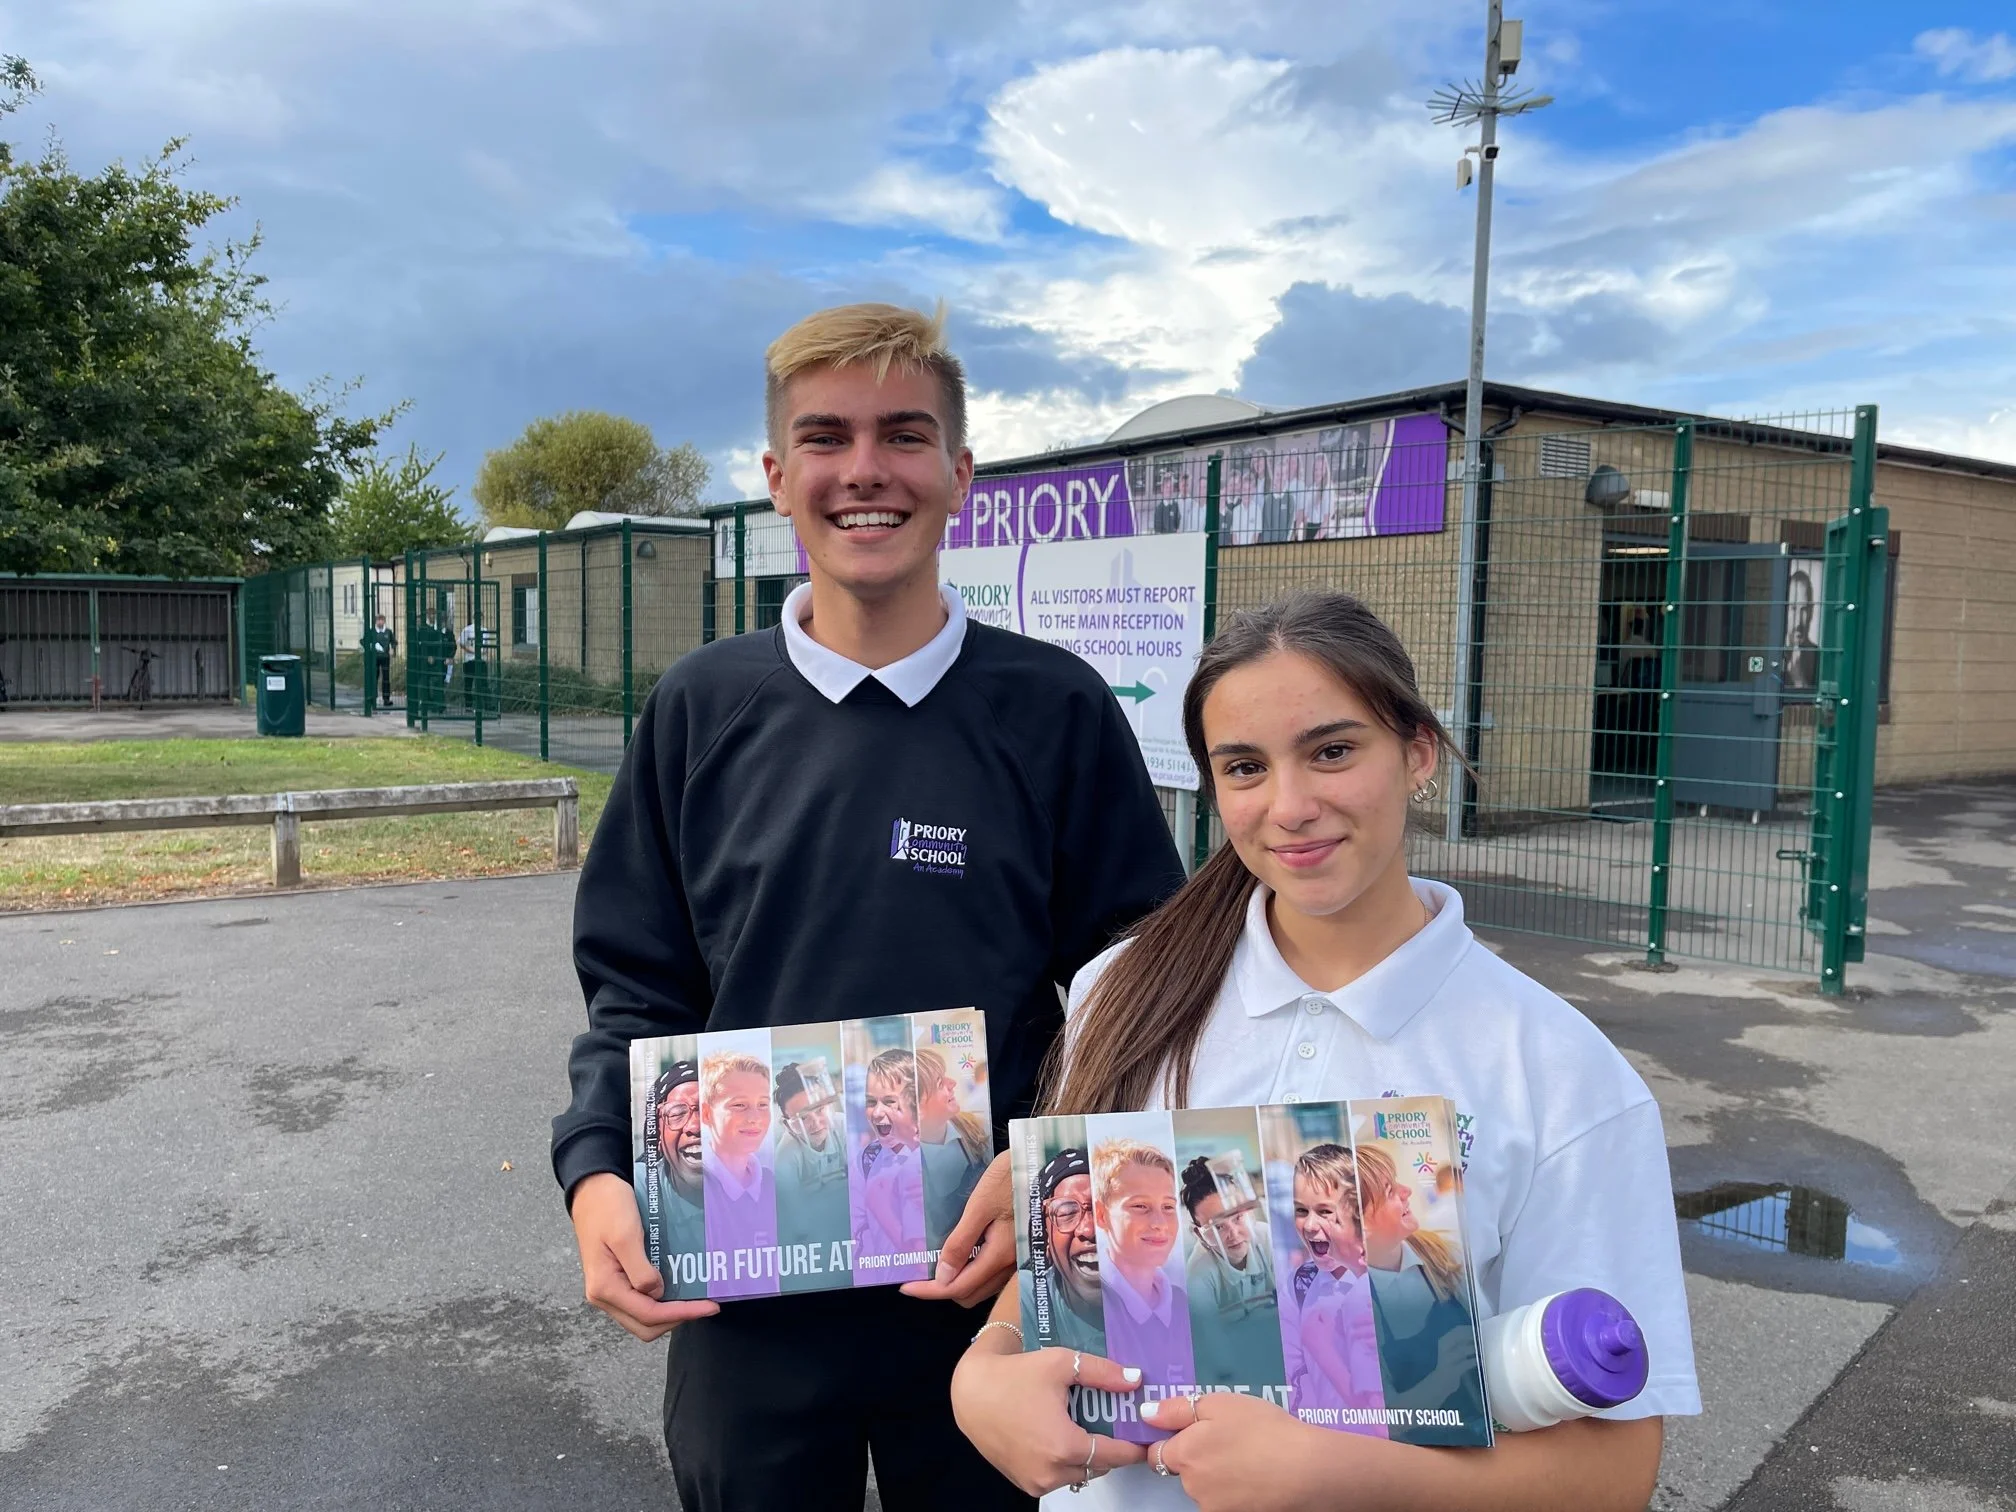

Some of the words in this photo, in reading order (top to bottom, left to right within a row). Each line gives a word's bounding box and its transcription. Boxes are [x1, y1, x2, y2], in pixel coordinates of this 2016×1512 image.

[972, 474, 1120, 549] PRIORY
[961, 584, 1012, 606] PRIORY
[1030, 590, 1050, 604] ALL
[1052, 588, 1103, 604] VISITORS
[1105, 587, 1141, 603] MUST
[1144, 586, 1196, 603] REPORT
[1038, 614, 1052, 629] TO
[1055, 614, 1076, 629] THE
[1078, 614, 1110, 630] MAIN
[1113, 614, 1184, 630] RECEPTION
[1083, 640, 1133, 656] SCHOOL
[1136, 641, 1182, 657] HOURS
[1145, 756, 1164, 770] 1934
[914, 823, 967, 841] PRIORY
[910, 848, 965, 865] SCHOOL
[646, 1104, 657, 1135] SERVING
[1387, 1111, 1428, 1123] PRIORY
[1389, 1129, 1431, 1139] SCHOOL
[647, 1144, 658, 1168] STAFF
[1026, 1134, 1041, 1198] COMMUNITIES
[649, 1168, 659, 1214] CHERISHING
[1030, 1199, 1043, 1237] SERVING
[650, 1223, 659, 1246] FIRST
[667, 1250, 728, 1285] YOUR
[734, 1242, 823, 1280] FUTURE
[829, 1239, 857, 1272] AT
[859, 1254, 892, 1269] PRIORY
[893, 1249, 942, 1266] COMMUNIT
[1033, 1248, 1046, 1277] STAFF
[1036, 1277, 1050, 1334] CHERISHING
[1067, 1384, 1138, 1422] YOUR
[1298, 1408, 1339, 1425] PRIORY
[1342, 1408, 1413, 1426] COMMUNITY
[1415, 1409, 1464, 1426] SCHOOL
